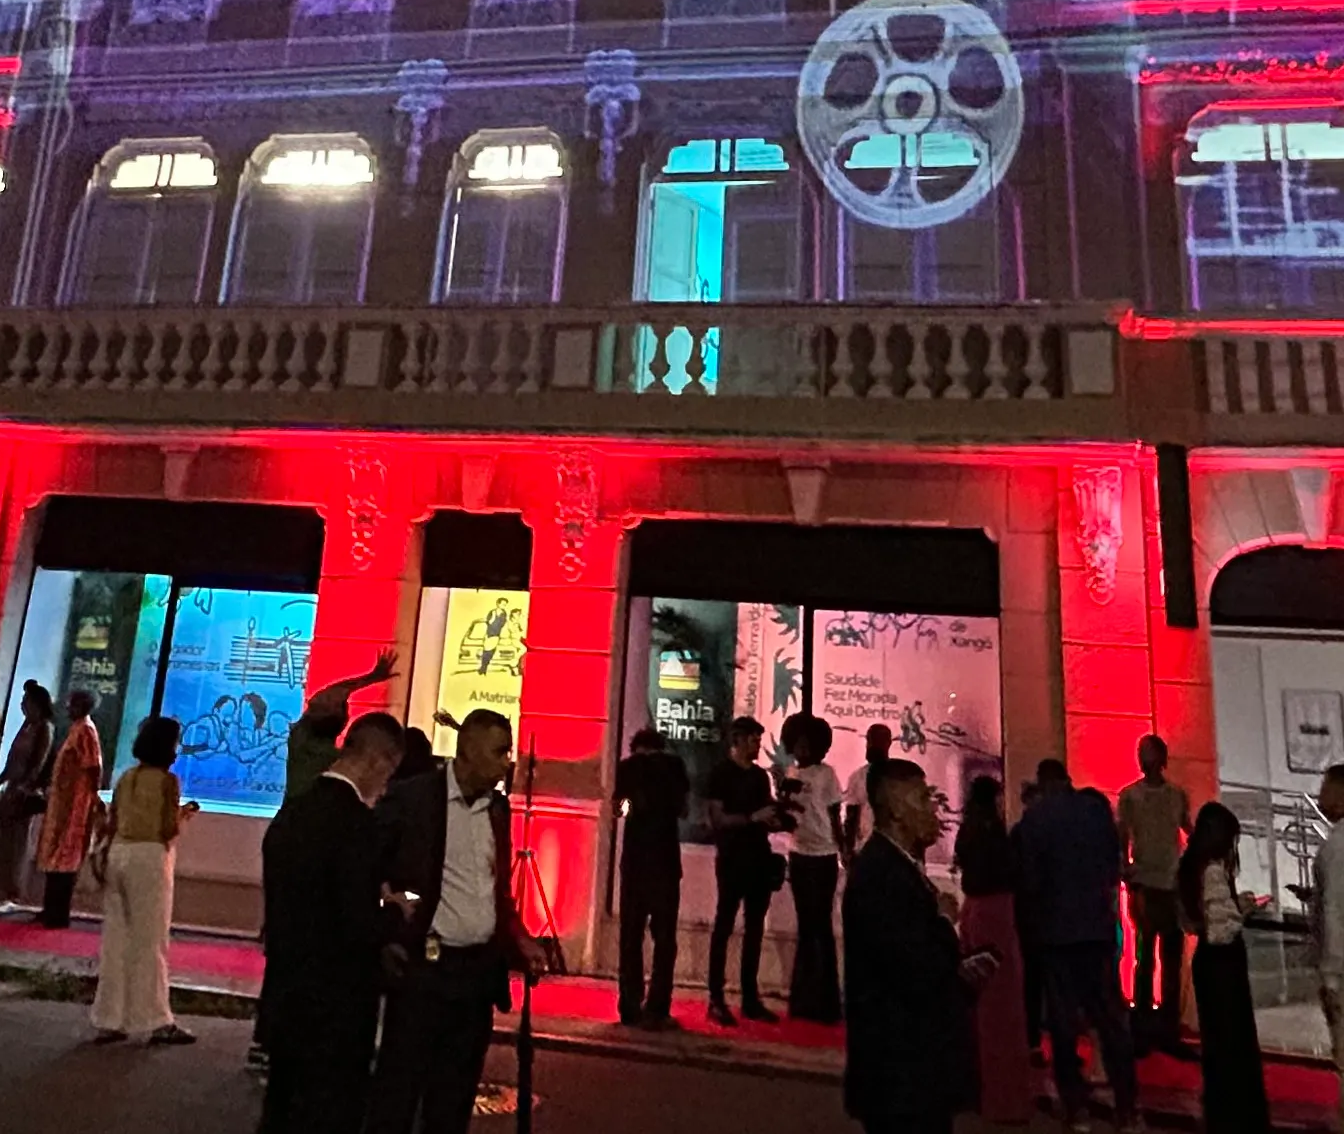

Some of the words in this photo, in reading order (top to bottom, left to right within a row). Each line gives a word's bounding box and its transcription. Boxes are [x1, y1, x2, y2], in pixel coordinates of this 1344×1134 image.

[949, 619, 967, 633] de
[70, 657, 116, 676] Bahia
[824, 672, 881, 688] Saudade
[824, 688, 846, 702] Fez
[848, 689, 898, 705] Morada
[657, 698, 714, 721] Bahia
[824, 703, 853, 718] Aqui
[857, 704, 901, 720] Dentro
[656, 719, 720, 743] Filmes
